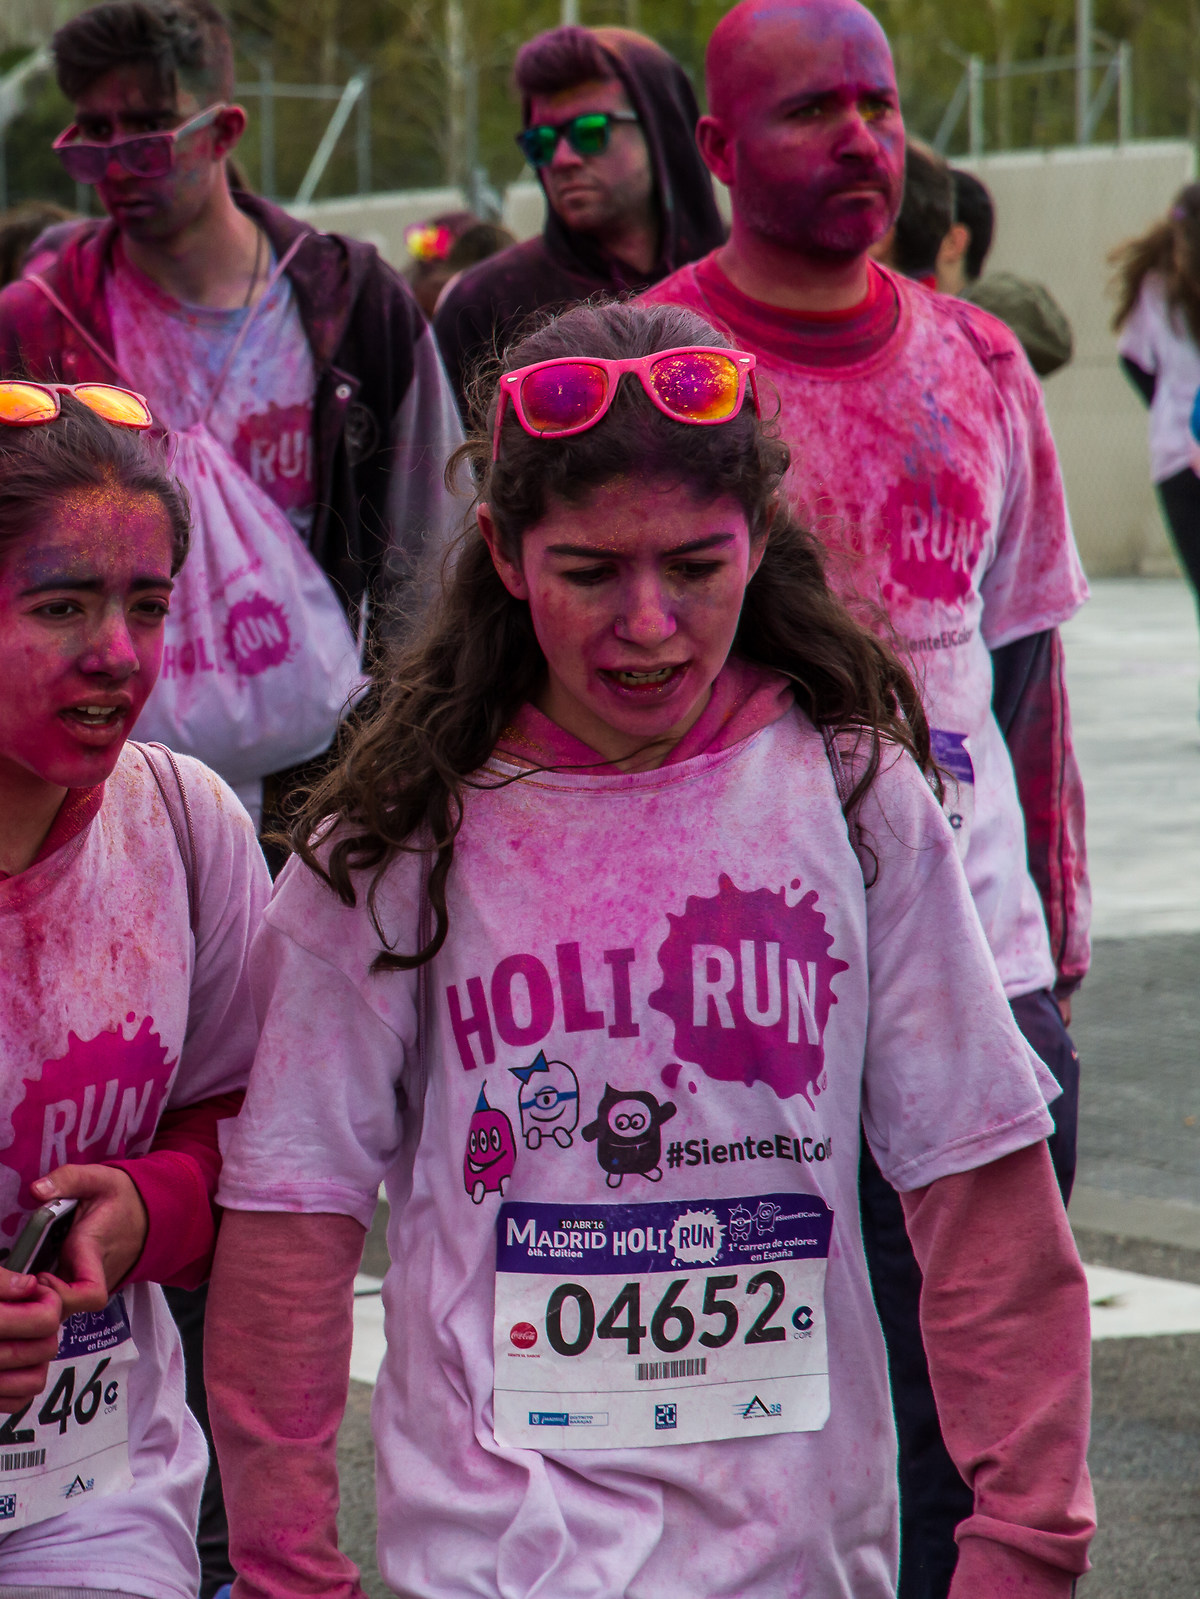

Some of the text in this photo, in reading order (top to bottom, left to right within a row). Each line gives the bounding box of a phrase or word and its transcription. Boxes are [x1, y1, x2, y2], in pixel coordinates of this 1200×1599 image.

[901, 503, 978, 574] RUN
[446, 939, 820, 1071] HOLI RUN
[39, 1078, 155, 1177] RUN
[561, 1220, 605, 1230] 10 ABR'16
[506, 1217, 715, 1256] MADRID HOLI RUN
[738, 1241, 771, 1252] carrera
[771, 1239, 783, 1248] de
[783, 1237, 818, 1247] colores
[527, 1248, 584, 1258] 6th. Edition
[750, 1249, 794, 1262] en España
[545, 1270, 787, 1357] 04652
[78, 1330, 103, 1343] carrera
[103, 1326, 111, 1336] de
[793, 1331, 813, 1340] COPE
[87, 1336, 118, 1352] en España
[656, 1404, 677, 1425] 20
